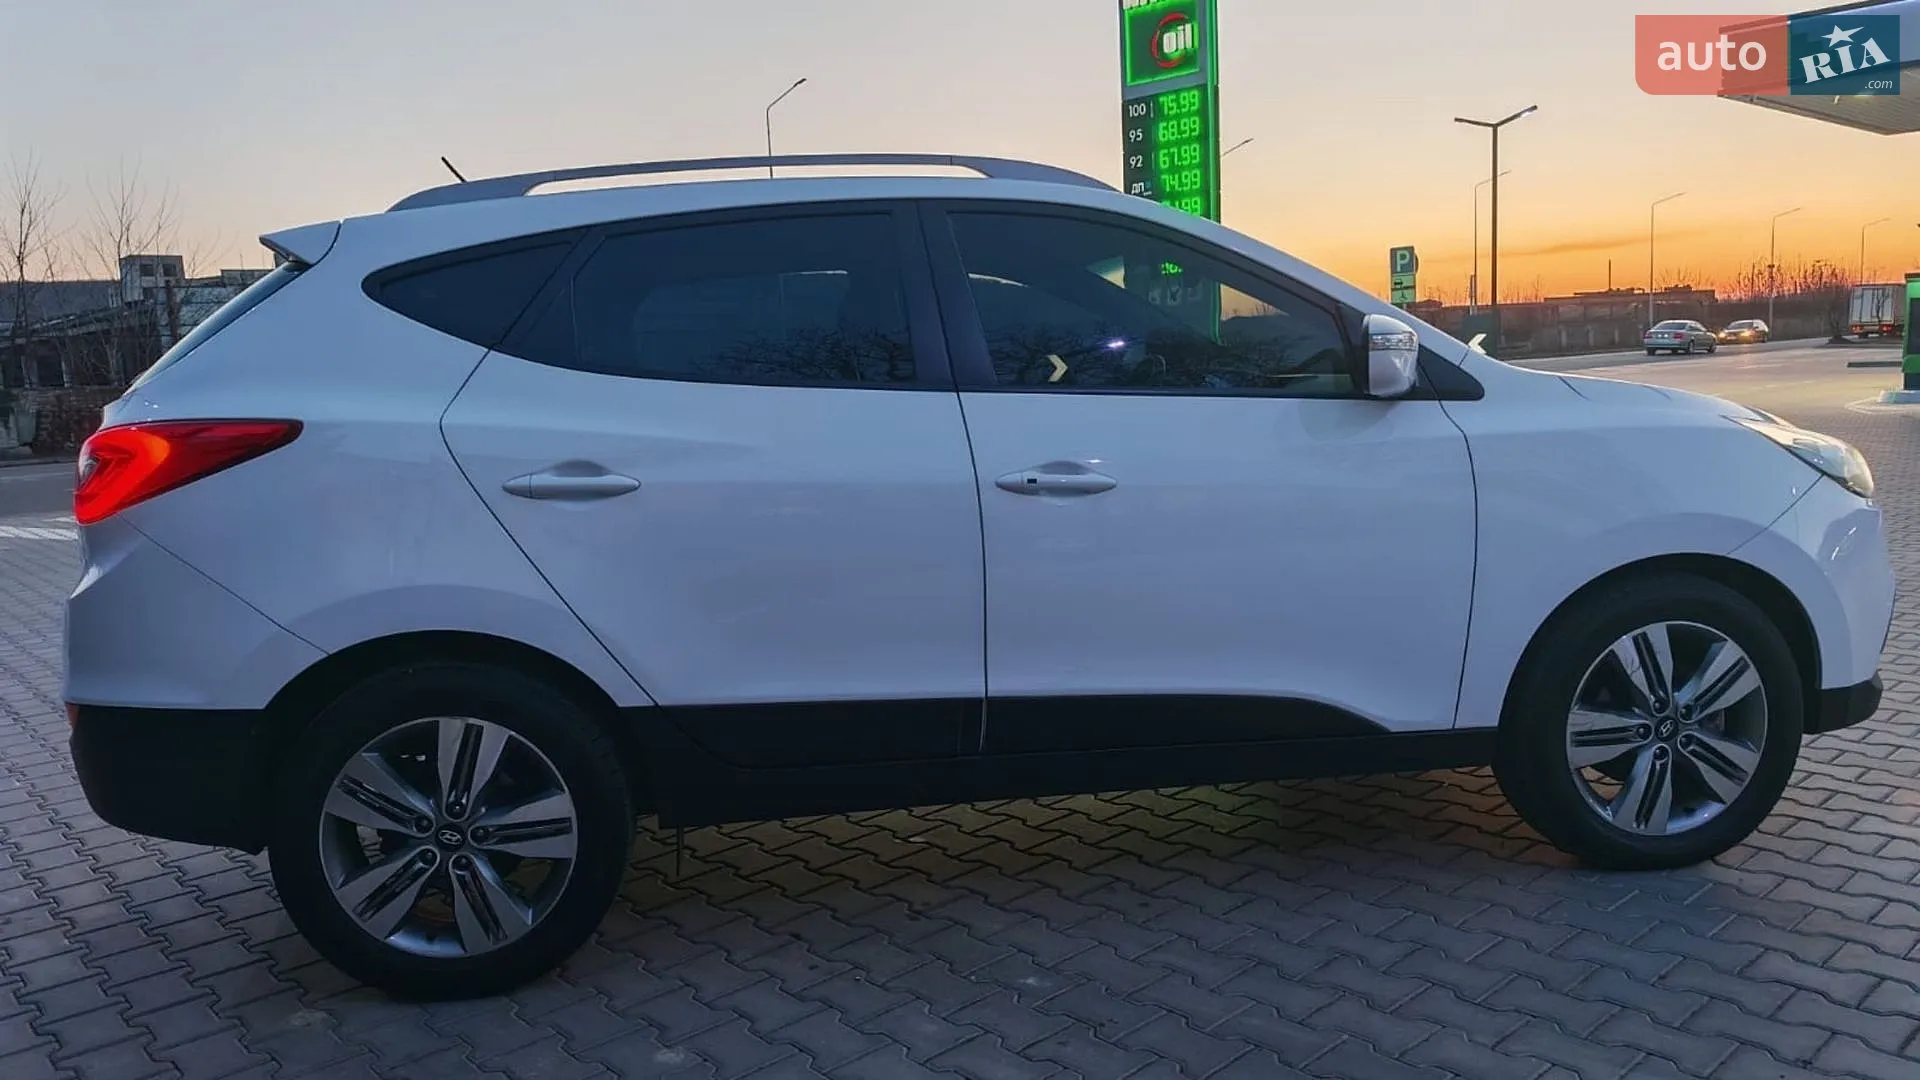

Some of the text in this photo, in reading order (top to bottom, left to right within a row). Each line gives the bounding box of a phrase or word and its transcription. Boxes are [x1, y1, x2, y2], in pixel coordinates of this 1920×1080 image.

[1163, 24, 1193, 53] oil
[1129, 90, 1199, 118] 100 75.99
[1129, 116, 1199, 142] 95 68.99
[1129, 143, 1200, 169] 92 67.99
[1160, 170, 1200, 192] 74.99
[1396, 250, 1410, 272] P
